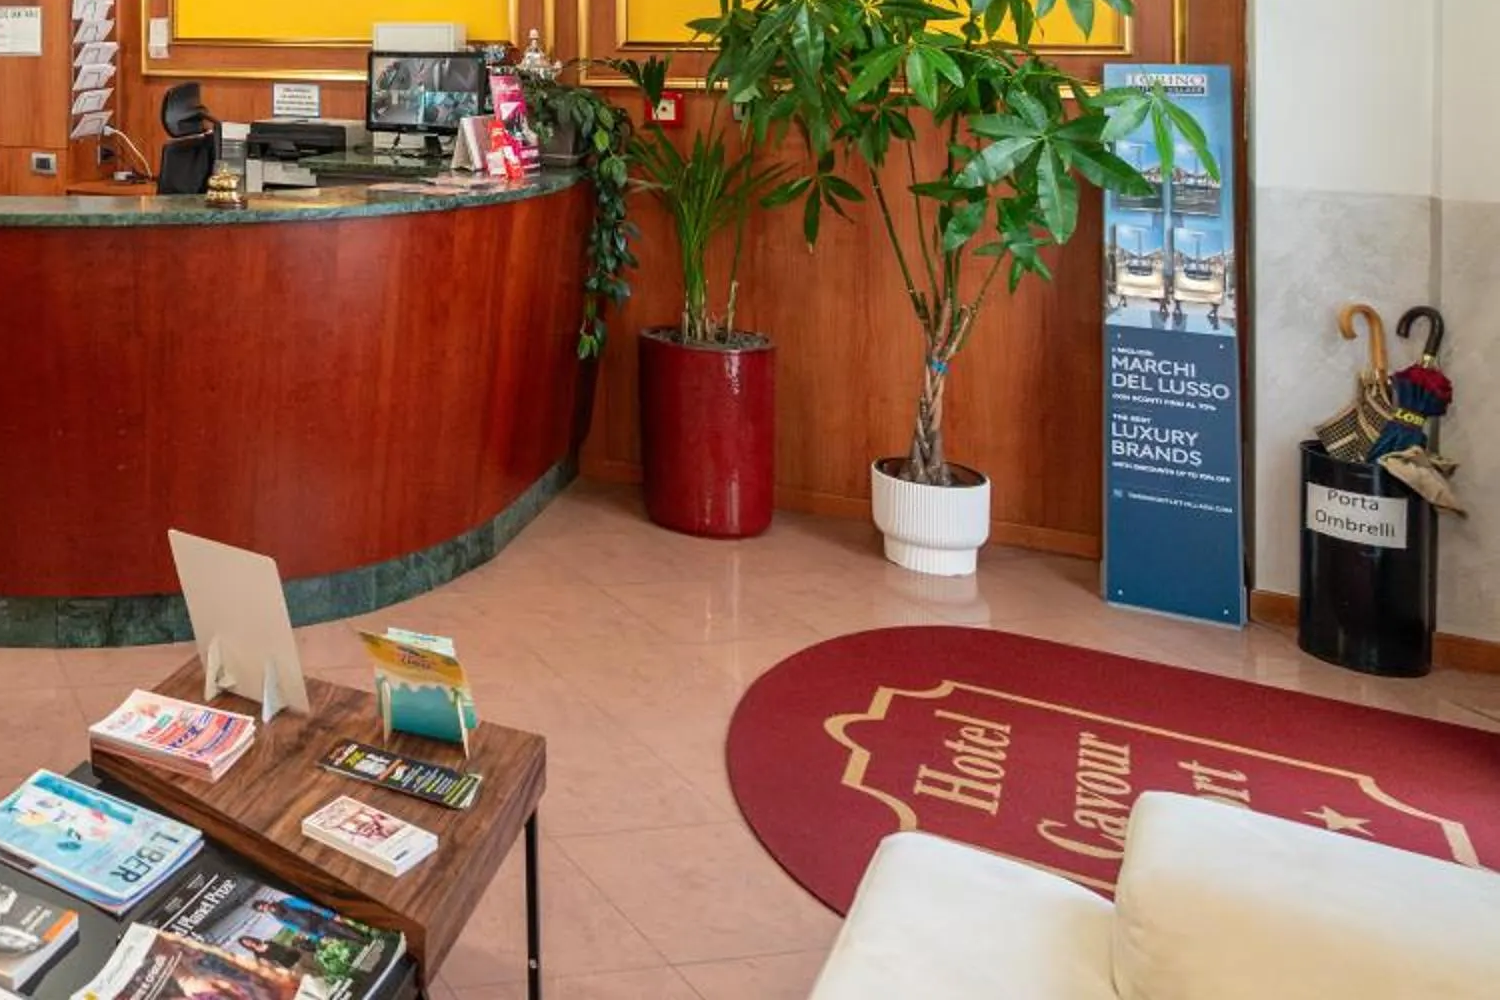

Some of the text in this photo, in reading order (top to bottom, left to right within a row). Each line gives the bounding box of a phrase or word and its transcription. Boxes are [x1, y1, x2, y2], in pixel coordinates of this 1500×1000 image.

[1111, 355, 1196, 378] MARCHI
[1111, 372, 1231, 400] DEL LUSSO
[1111, 421, 1199, 447] LUXURY
[1111, 439, 1202, 467] BRANDS
[1327, 488, 1379, 512] Porta
[1315, 509, 1396, 538] Ombrelli
[913, 709, 1011, 817] Hotel
[1036, 731, 1132, 860] Cavour
